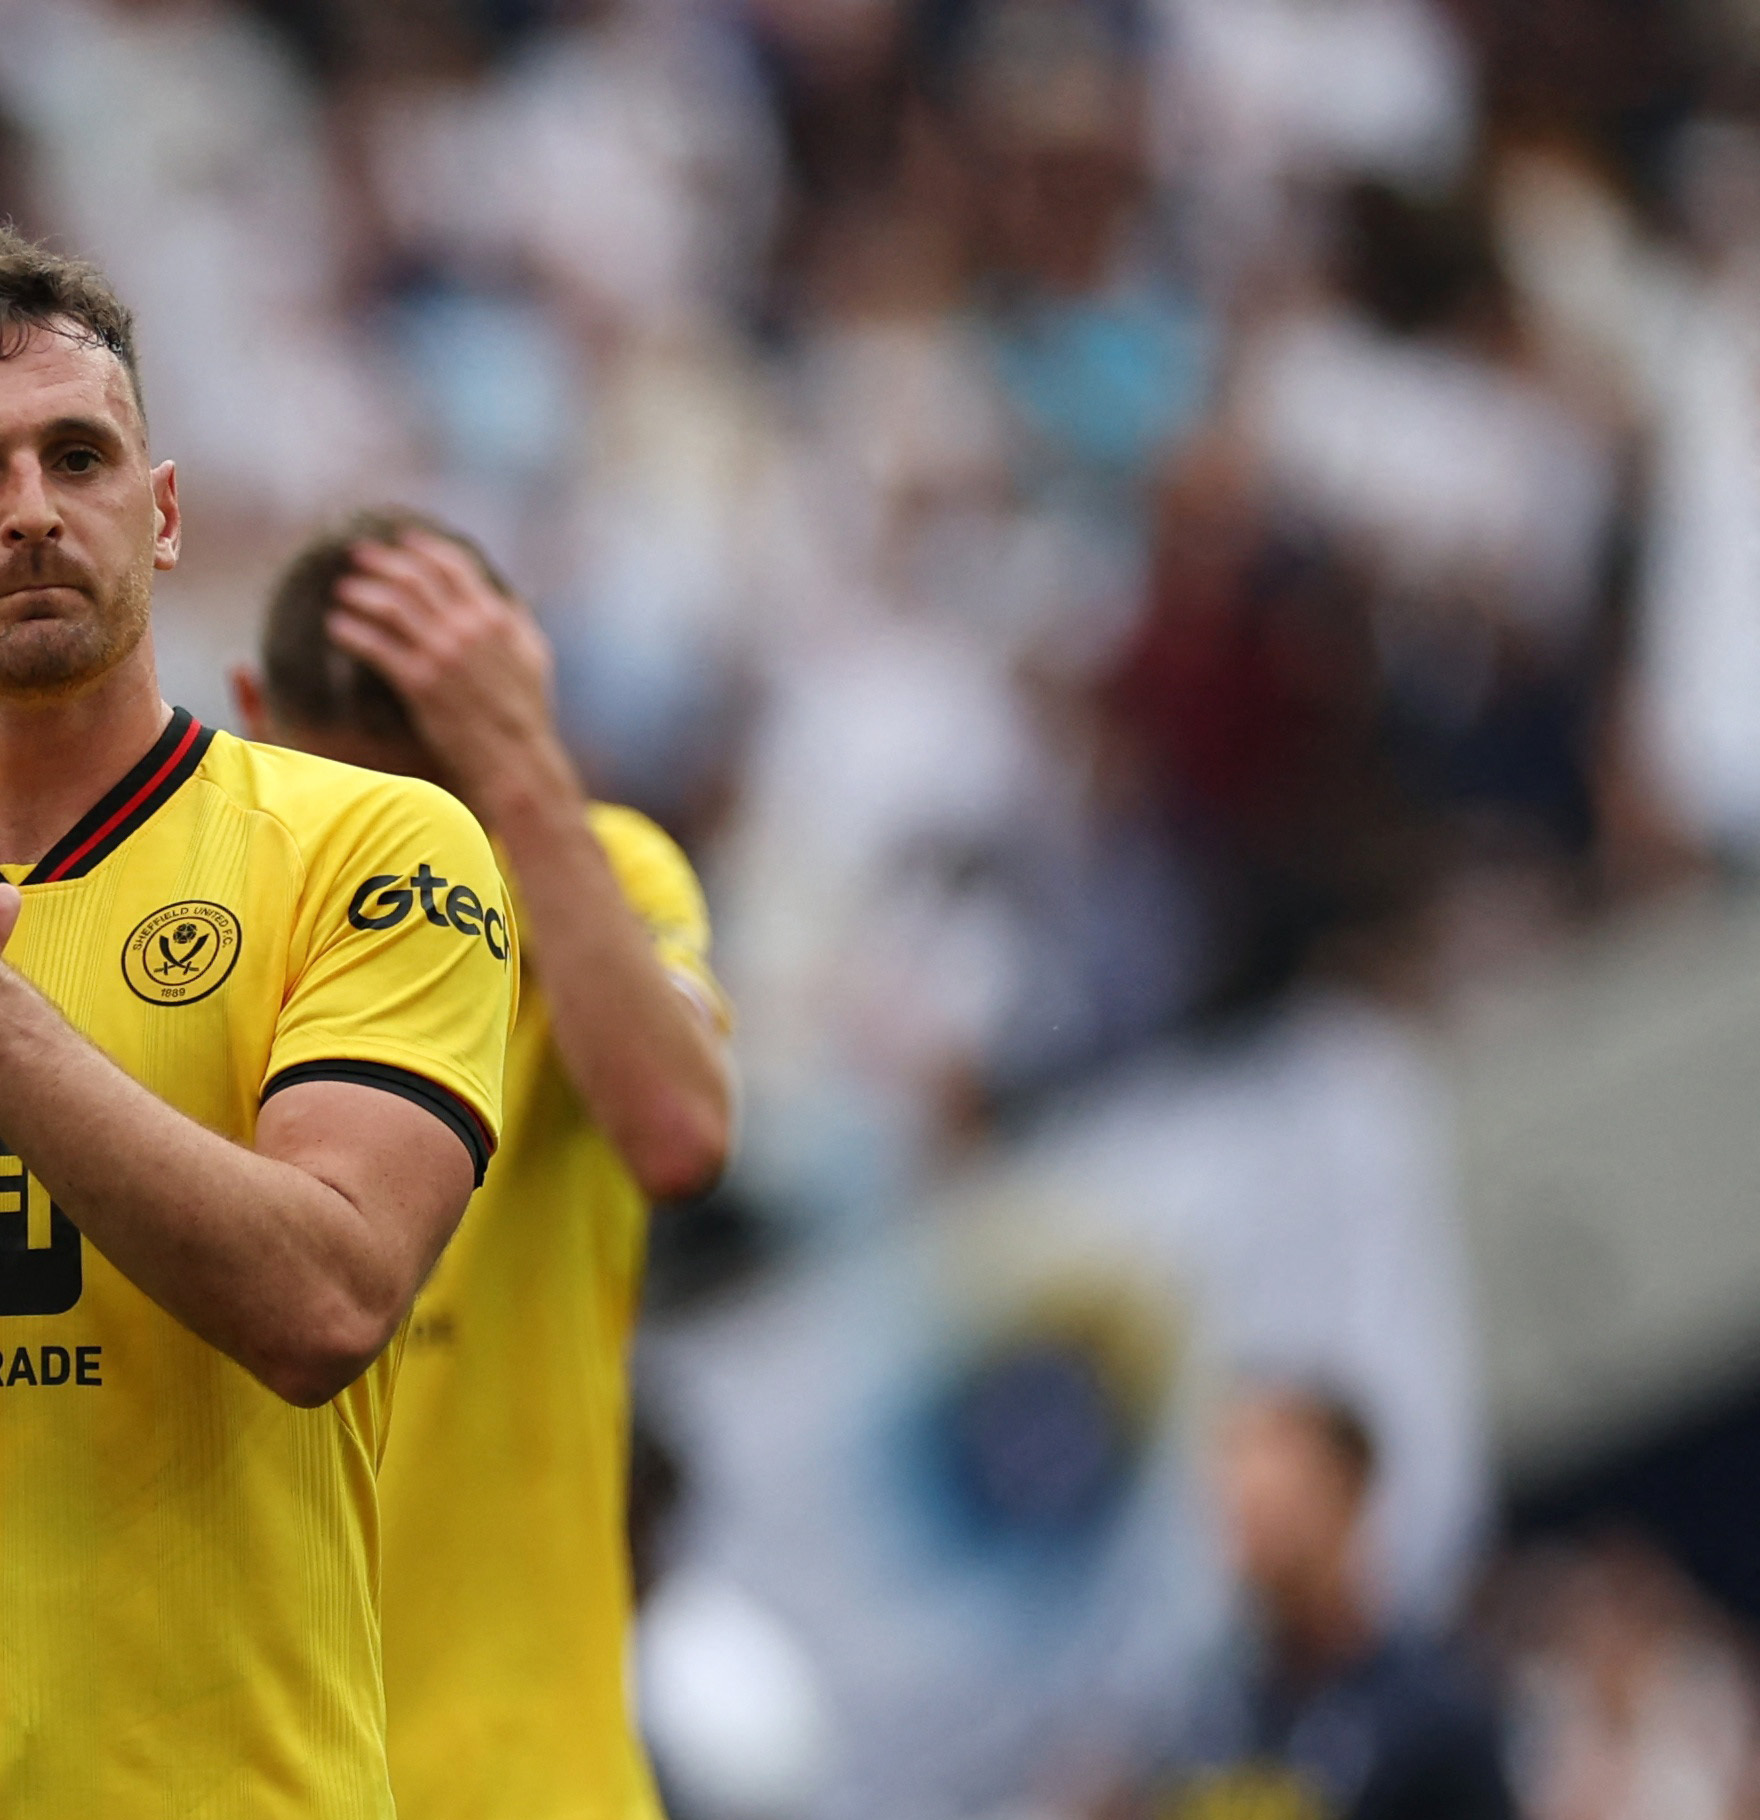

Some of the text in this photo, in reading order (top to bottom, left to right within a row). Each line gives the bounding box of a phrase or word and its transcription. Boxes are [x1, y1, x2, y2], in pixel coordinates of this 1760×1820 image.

[132, 906, 233, 951] SHEFFIELD UNITED F.C.
[161, 987, 186, 998] 1889
